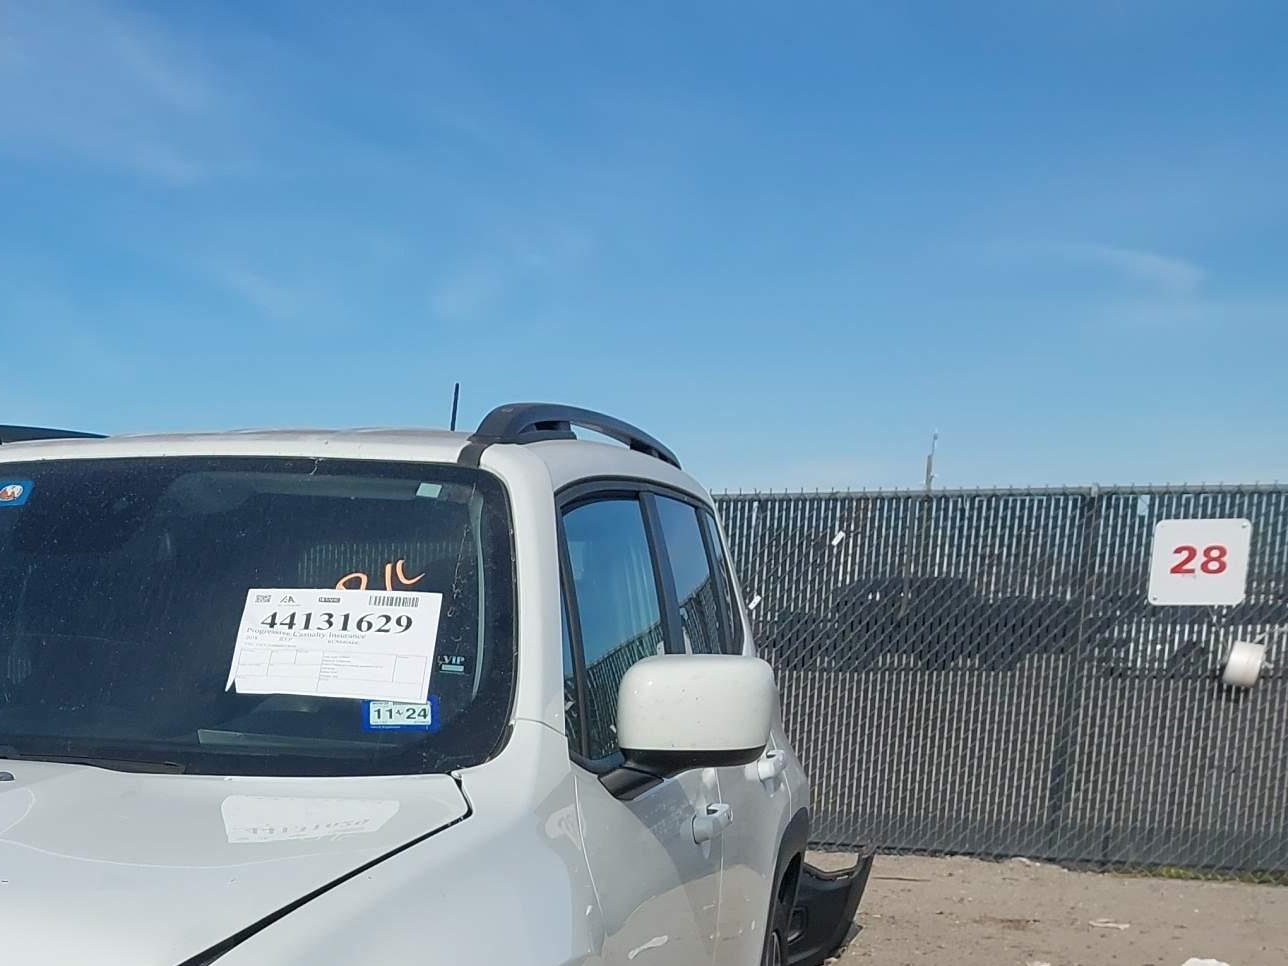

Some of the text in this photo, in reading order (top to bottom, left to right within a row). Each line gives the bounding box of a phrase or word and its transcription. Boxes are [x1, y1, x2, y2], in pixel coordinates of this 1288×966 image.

[1169, 545, 1228, 575] 28
[260, 611, 414, 634] 44131629
[405, 707, 429, 720] 24
